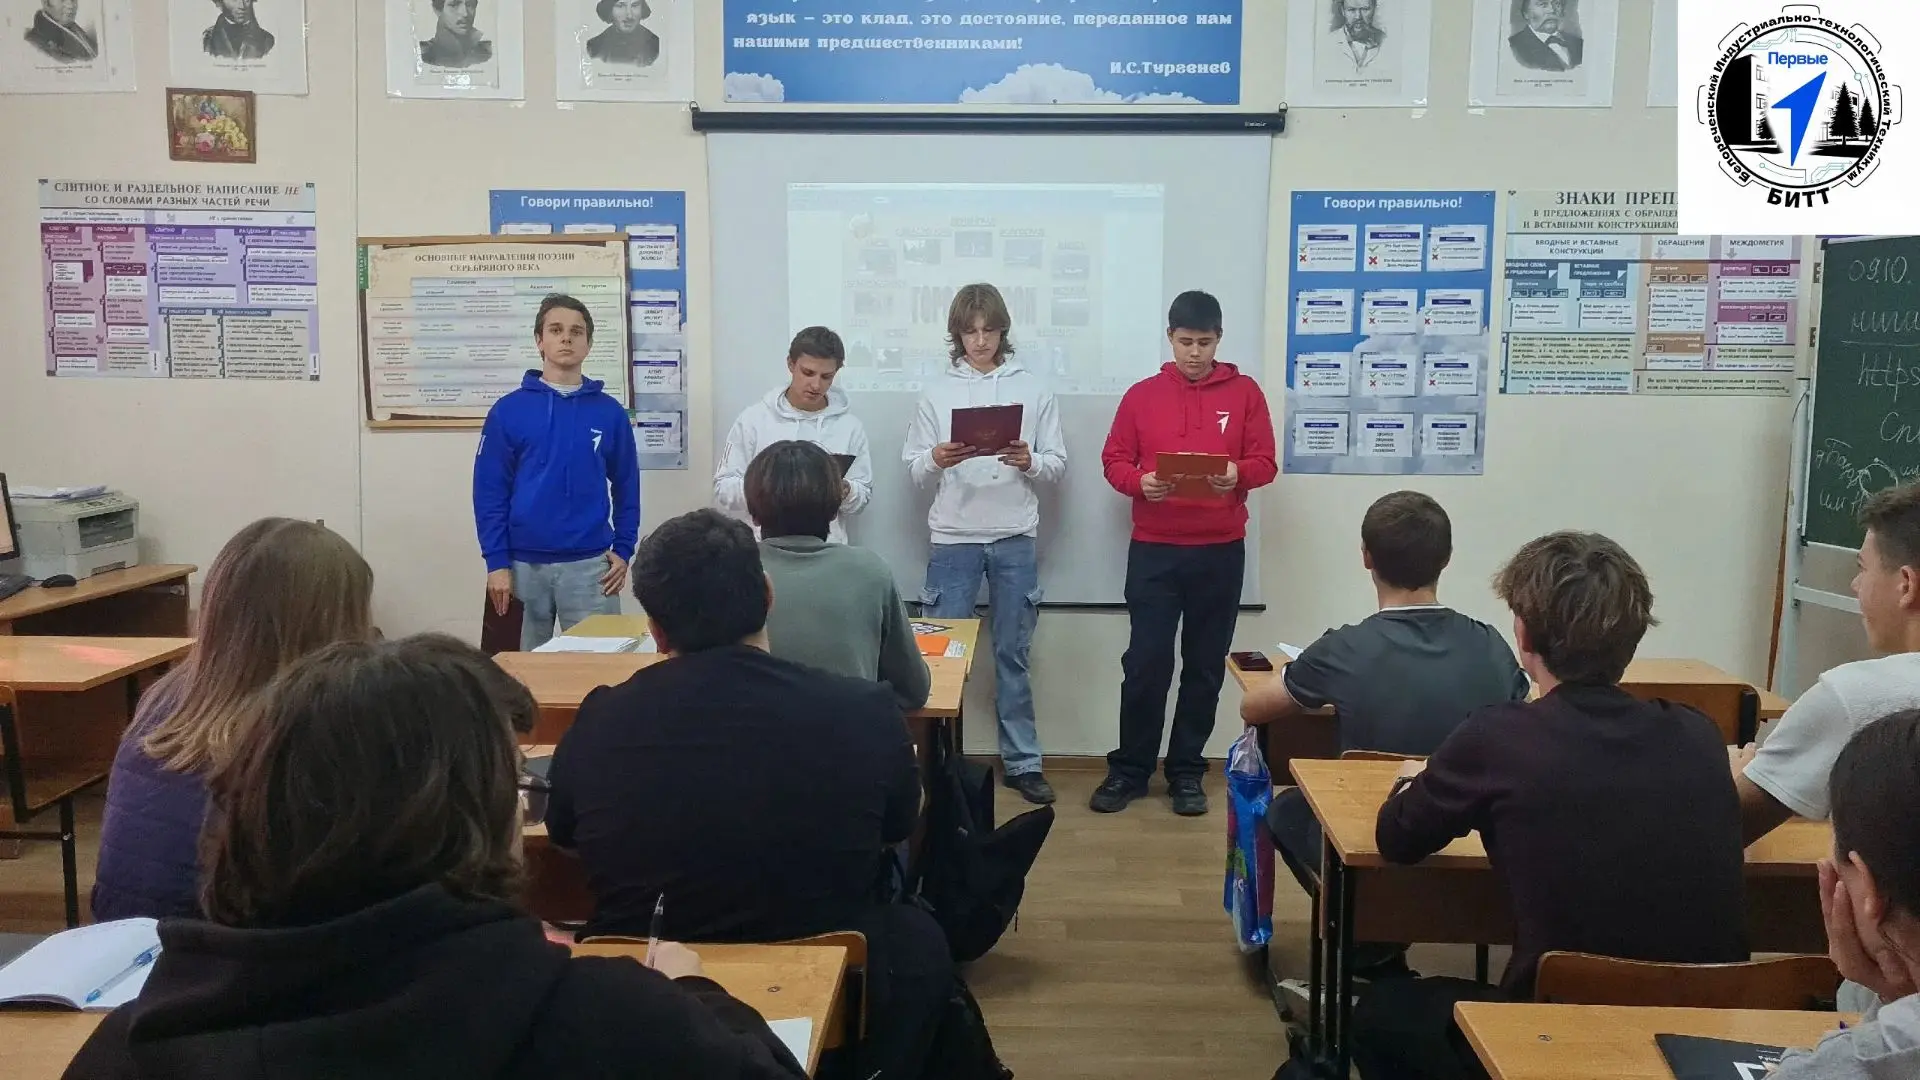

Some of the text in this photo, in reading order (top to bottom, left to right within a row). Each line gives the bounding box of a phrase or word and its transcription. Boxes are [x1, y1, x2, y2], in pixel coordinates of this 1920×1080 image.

[746, 12, 796, 26] язык
[822, 13, 854, 25] это
[921, 13, 953, 25] это
[1073, 13, 1188, 28] переданное
[1196, 13, 1233, 25] нам
[732, 36, 1023, 51] нашими предшественниками!
[1110, 61, 1231, 77] И.С.Тургенев
[54, 182, 110, 193] СЛИТНОЕ
[113, 183, 122, 193] И
[127, 183, 202, 194] РАЗДЕЛЬНОЕ
[84, 195, 270, 206] СО СЛОВАМИ РАЗНЫХ ЧАСТЕЙ РЕЧИ
[520, 195, 653, 210] Говори правильно!
[1323, 196, 1463, 211] Говори правильно!
[1555, 191, 1678, 205] ЗНАКИ ПРЕП
[1543, 209, 1621, 218] ПРЕДЛОЖЕНИЯХ
[1534, 221, 1593, 229] ВСТАВНЫМИ
[1657, 239, 1705, 247] ОБРАЩЕНИЯ
[1729, 239, 1785, 247] МЕЖДОМЕТИЯ
